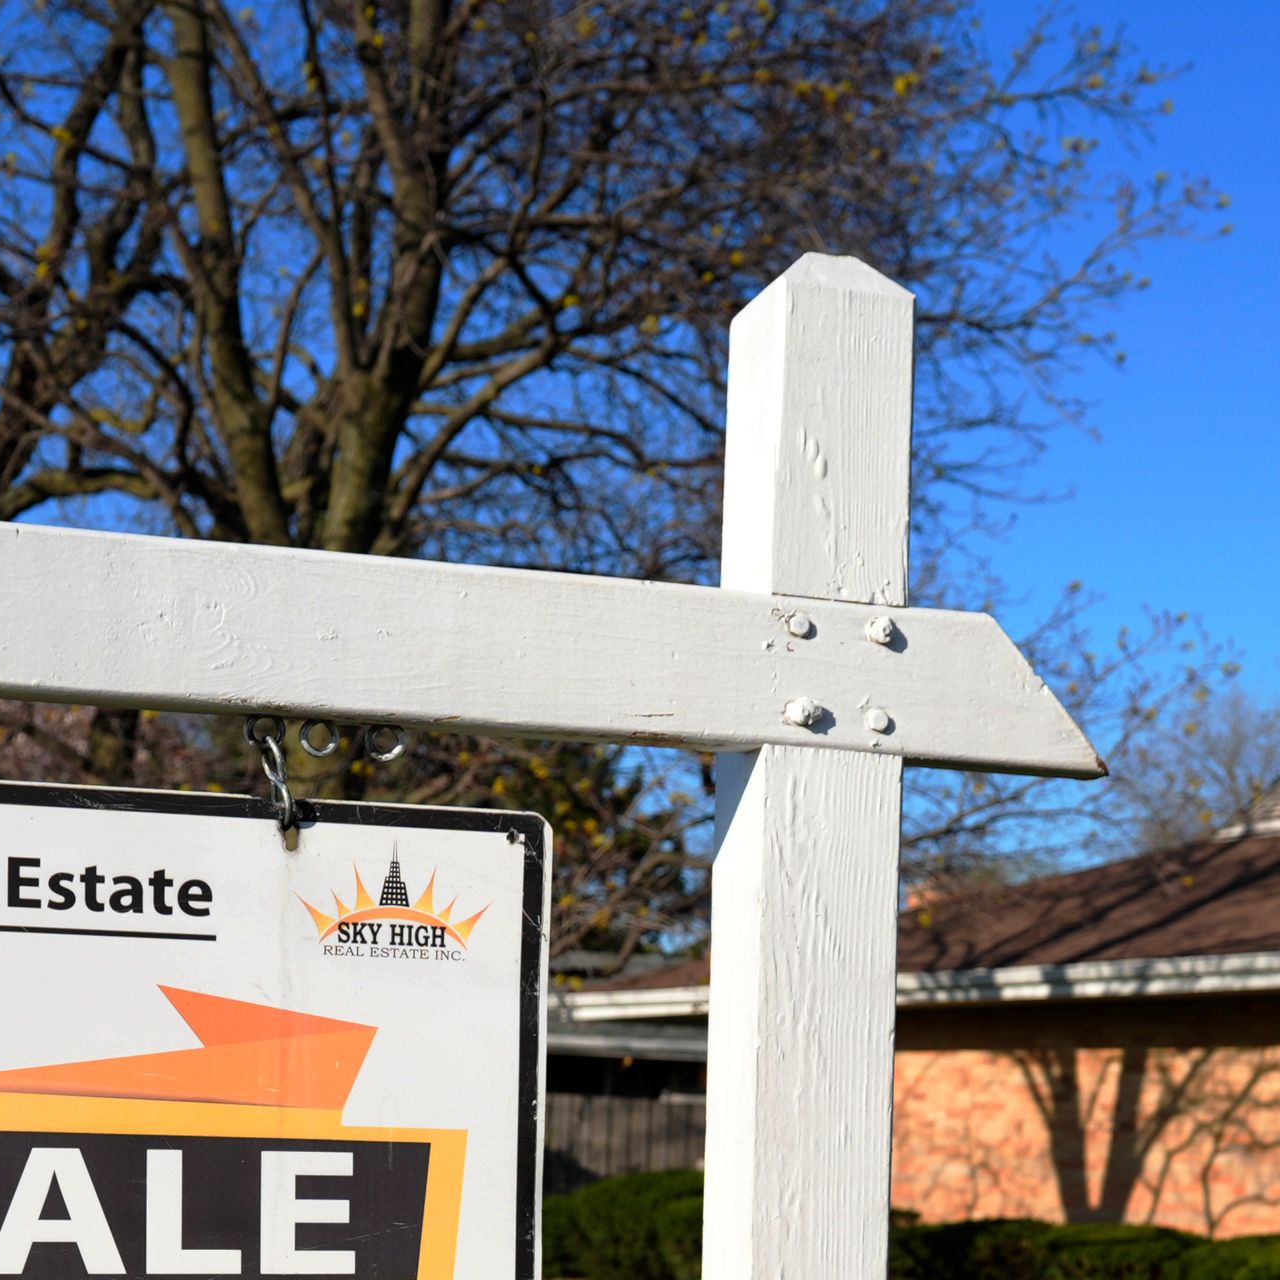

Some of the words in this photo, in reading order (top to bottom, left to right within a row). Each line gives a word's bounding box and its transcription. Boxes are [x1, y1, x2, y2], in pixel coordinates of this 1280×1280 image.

[6, 856, 214, 918] Estate
[337, 921, 382, 945] SKY
[389, 923, 447, 948] HIGH
[323, 944, 365, 957] REAL
[370, 946, 429, 960] ESTATE
[434, 949, 466, 962] INC.
